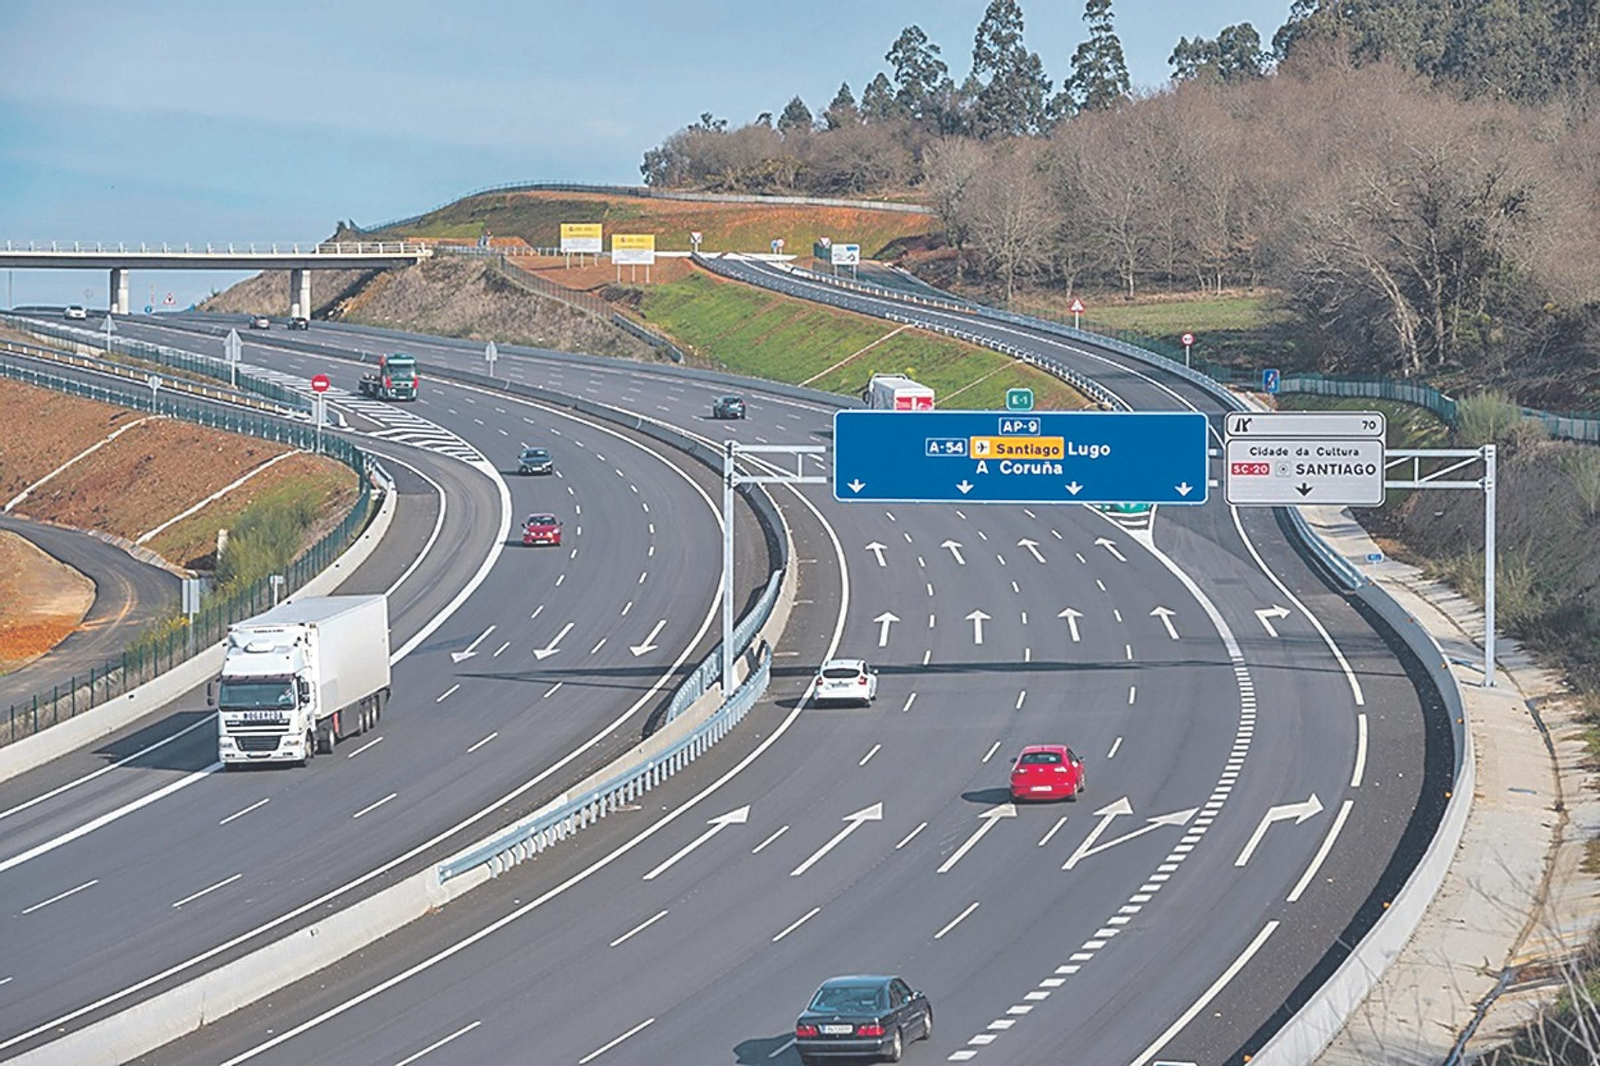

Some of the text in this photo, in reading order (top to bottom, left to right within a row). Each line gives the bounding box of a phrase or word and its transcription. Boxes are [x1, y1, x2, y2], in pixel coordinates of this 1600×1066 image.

[1002, 420, 1038, 433] AP-9
[1362, 420, 1377, 430] 70
[929, 441, 1111, 458] A-54 Santiago Lugo
[1250, 447, 1360, 456] Cidade da Cultura
[975, 460, 1063, 475] A Coruña
[1233, 463, 1377, 475] SC-20 SANTIAGO
